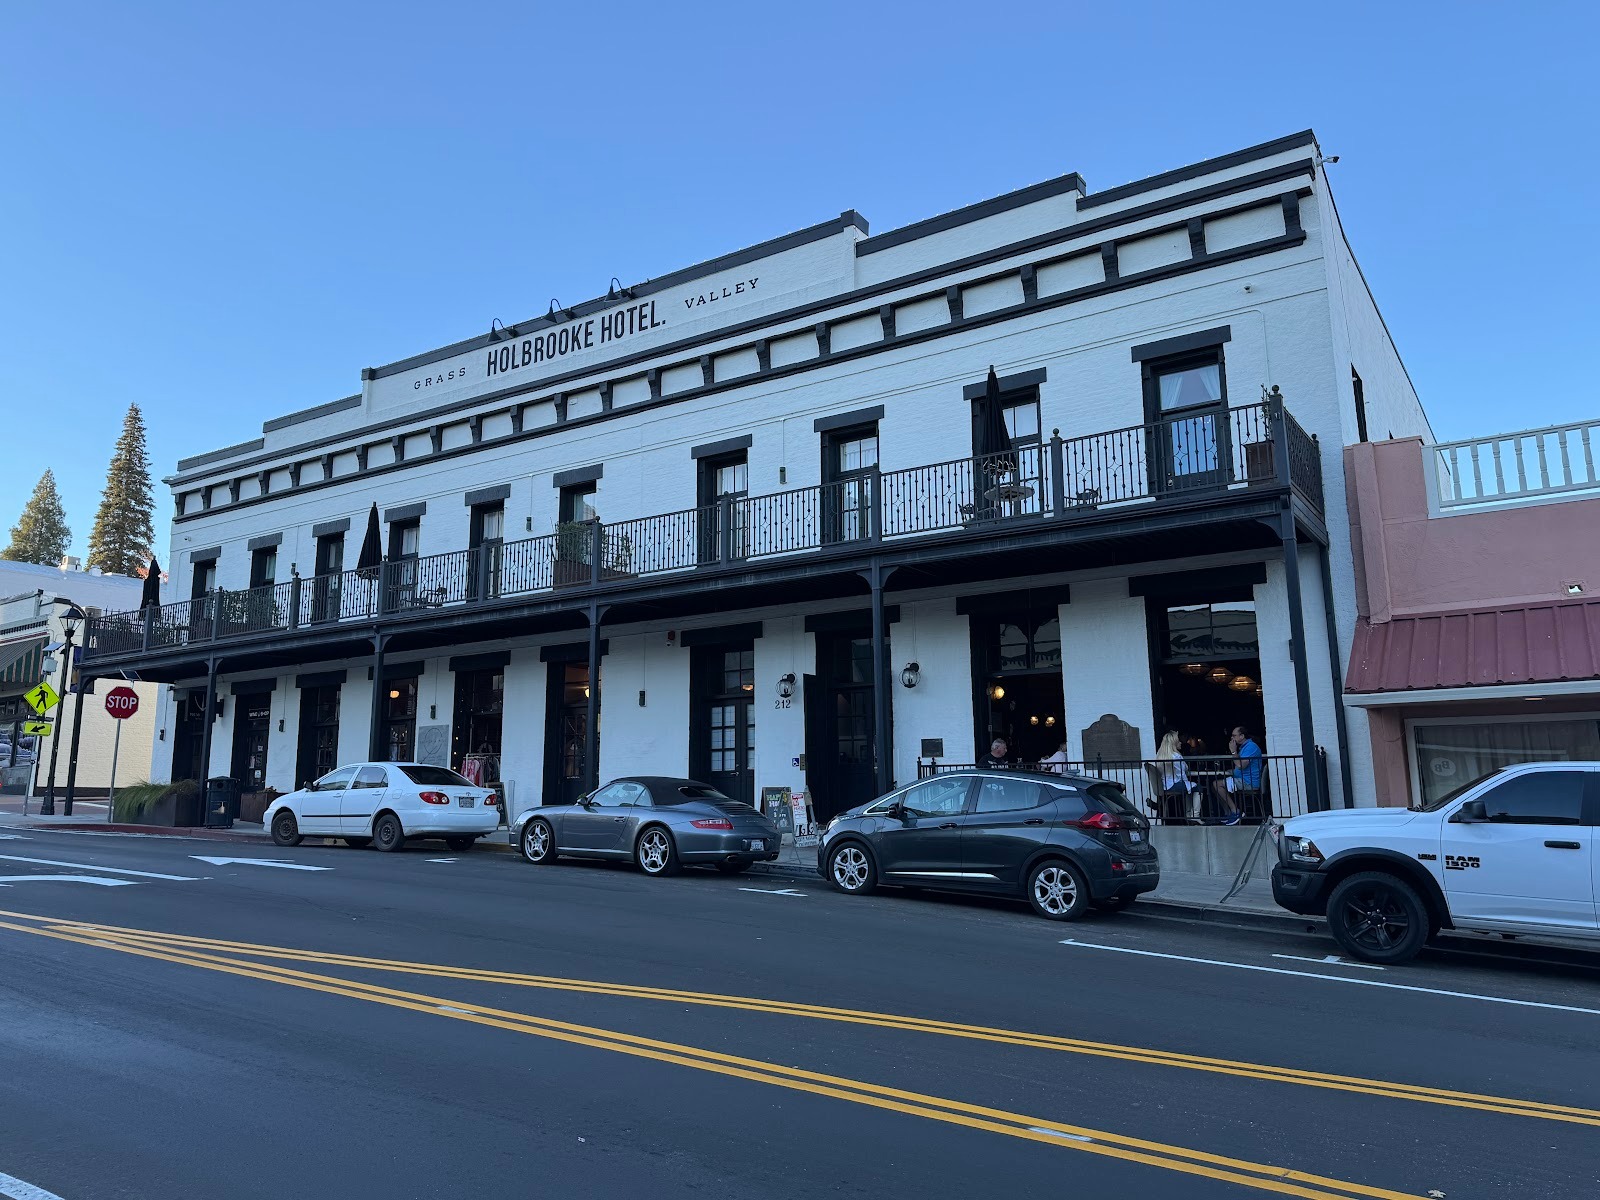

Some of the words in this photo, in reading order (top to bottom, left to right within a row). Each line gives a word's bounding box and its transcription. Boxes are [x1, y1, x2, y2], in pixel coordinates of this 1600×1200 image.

[684, 277, 759, 309] VALLEY
[486, 320, 595, 376] HOLBROOKE
[600, 300, 666, 344] HOTEL.
[414, 367, 466, 390] GRASS
[106, 695, 138, 710] STOP
[774, 699, 791, 710] 212
